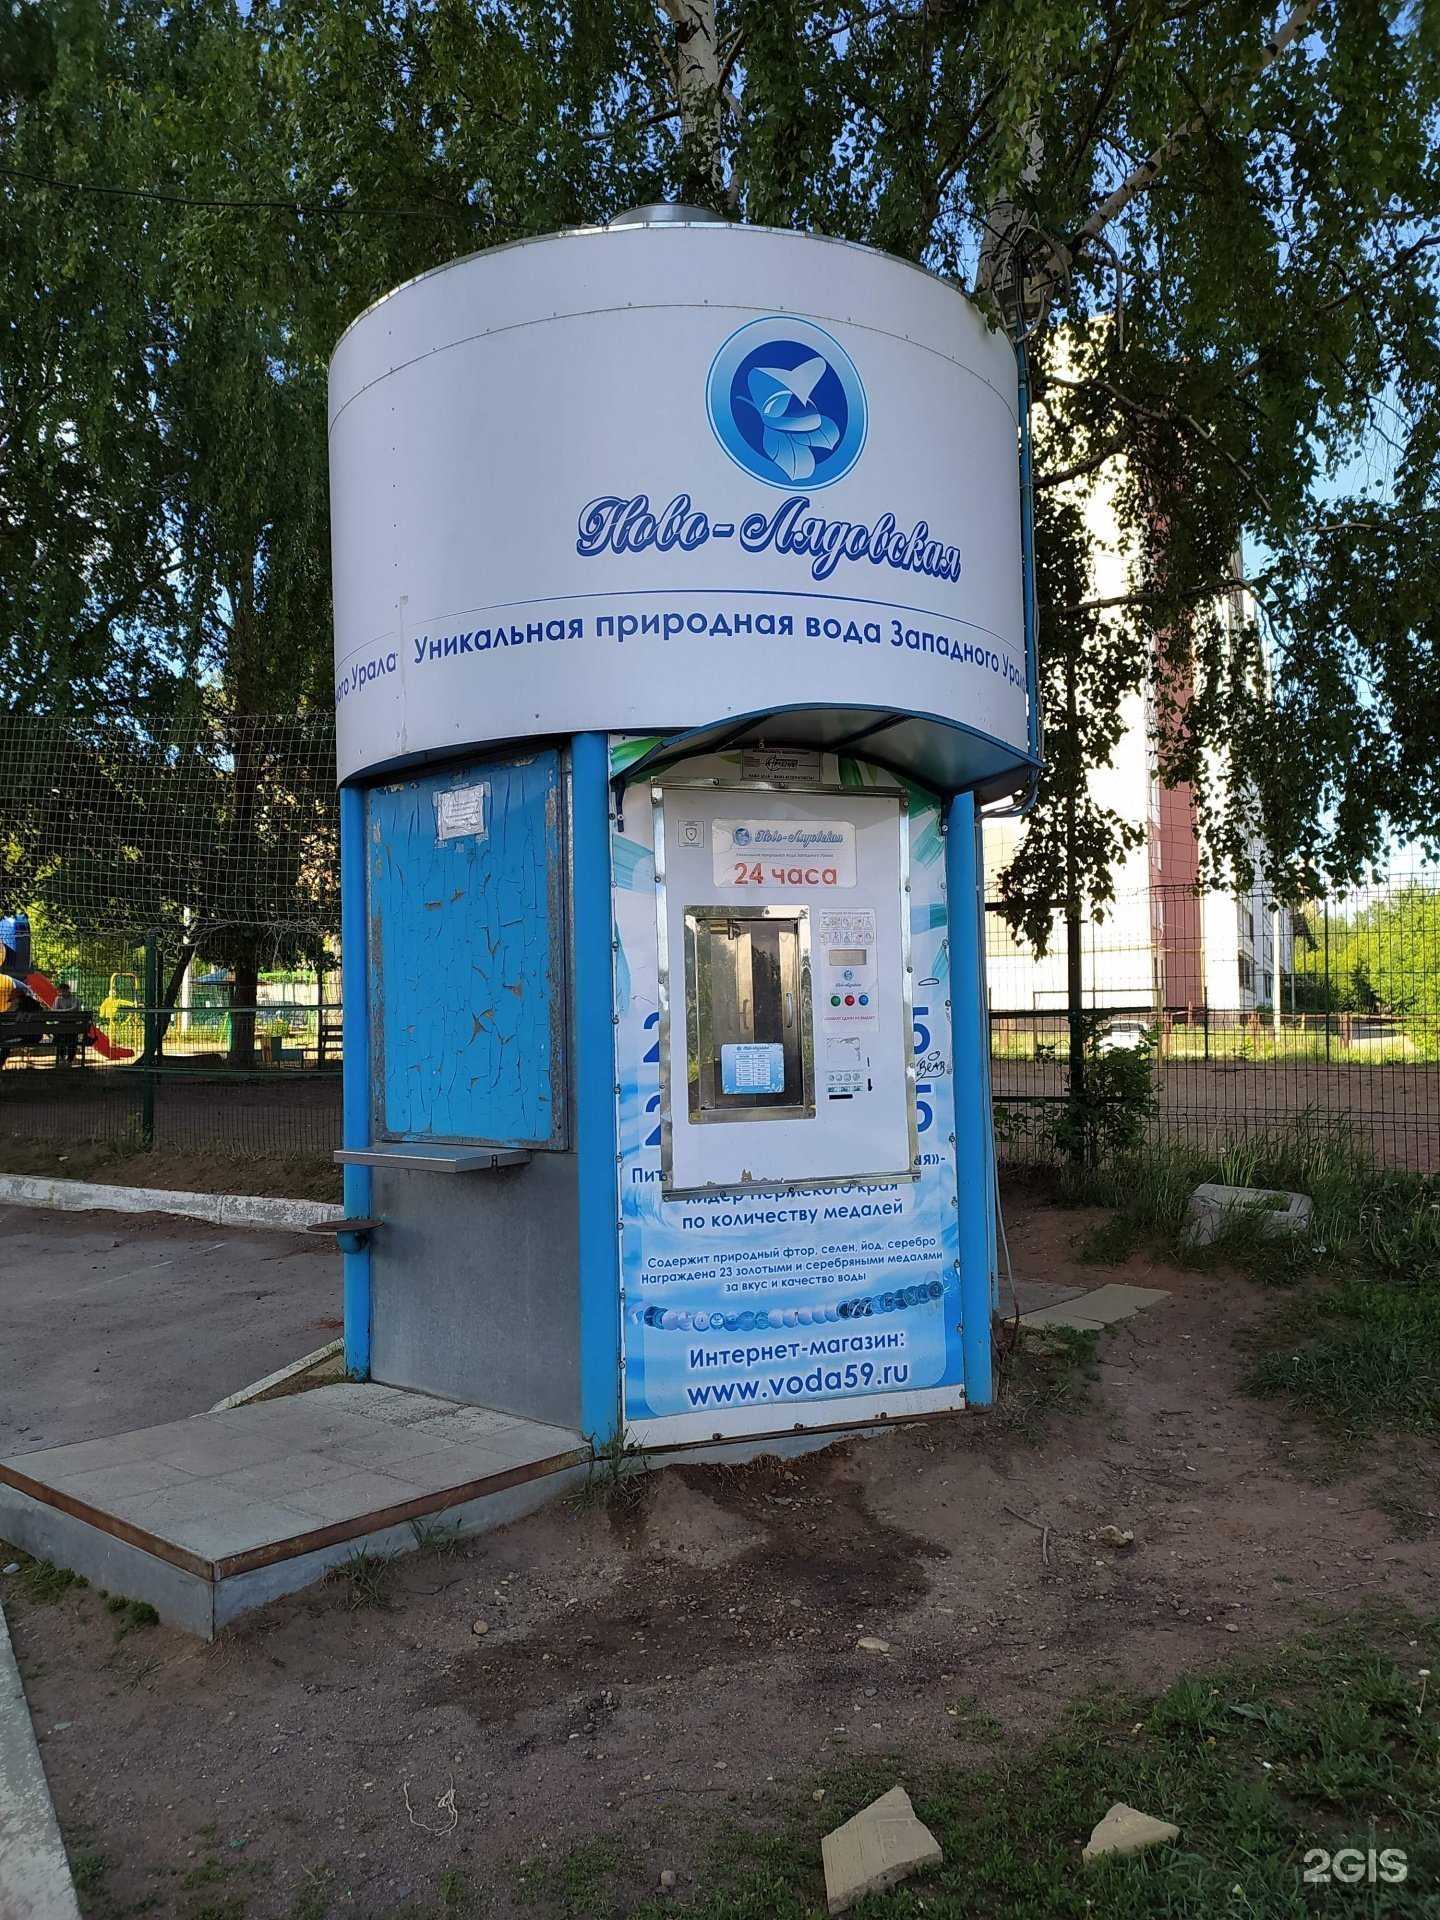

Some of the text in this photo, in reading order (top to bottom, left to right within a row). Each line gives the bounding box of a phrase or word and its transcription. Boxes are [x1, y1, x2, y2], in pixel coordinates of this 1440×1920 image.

[576, 493, 961, 582] Ново-Лядовская
[414, 615, 583, 664] Уникальная
[596, 612, 794, 642] природная
[806, 616, 881, 644] вода
[891, 620, 999, 673] Западного
[352, 652, 396, 692] Урала
[734, 862, 837, 885] 24 часа
[682, 1199, 903, 1230] по количеству медалей
[641, 1251, 943, 1285] Награждена 23 золотыми и серебряными медалями
[647, 1255, 710, 1269] Содержит
[713, 1248, 779, 1265] природный
[821, 1243, 858, 1255] селен,
[887, 1237, 936, 1250] серебро
[726, 1272, 866, 1292] за вкус и качество воды
[690, 1332, 905, 1368] Интернет-магазин:
[687, 1361, 908, 1406] www.voda59.ru
